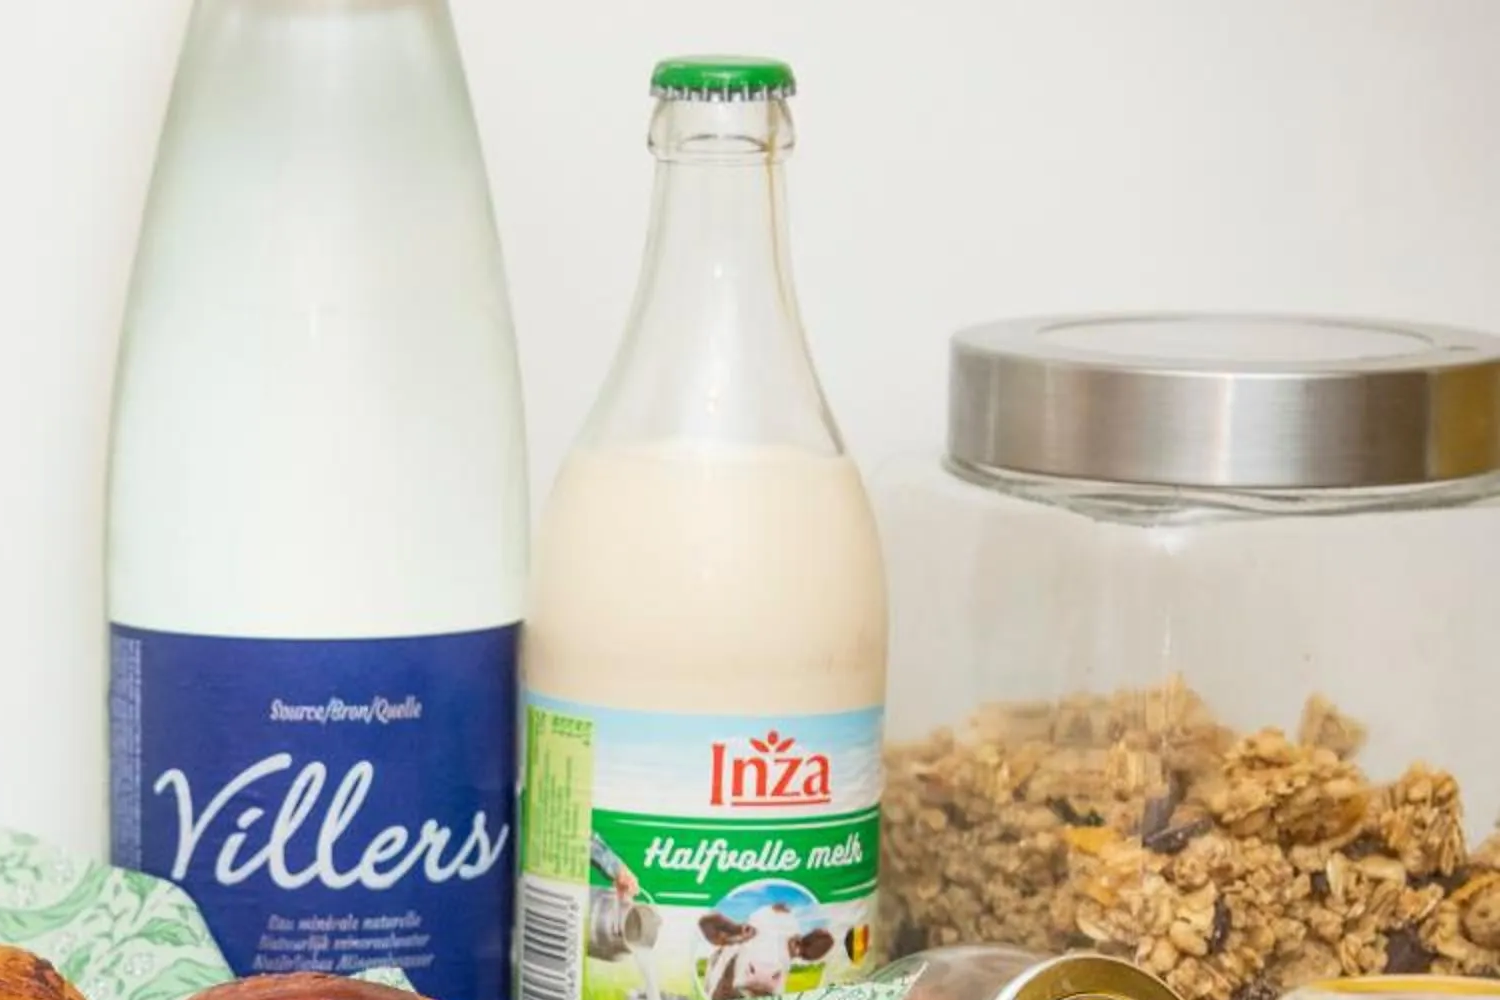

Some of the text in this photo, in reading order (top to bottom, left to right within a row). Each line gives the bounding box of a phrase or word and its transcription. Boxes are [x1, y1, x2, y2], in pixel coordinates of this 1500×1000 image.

[270, 695, 422, 724] Source/Bron/Quelle
[710, 741, 831, 806] Inza
[153, 752, 509, 890] Villers
[643, 832, 863, 884] Halfvolle melk
